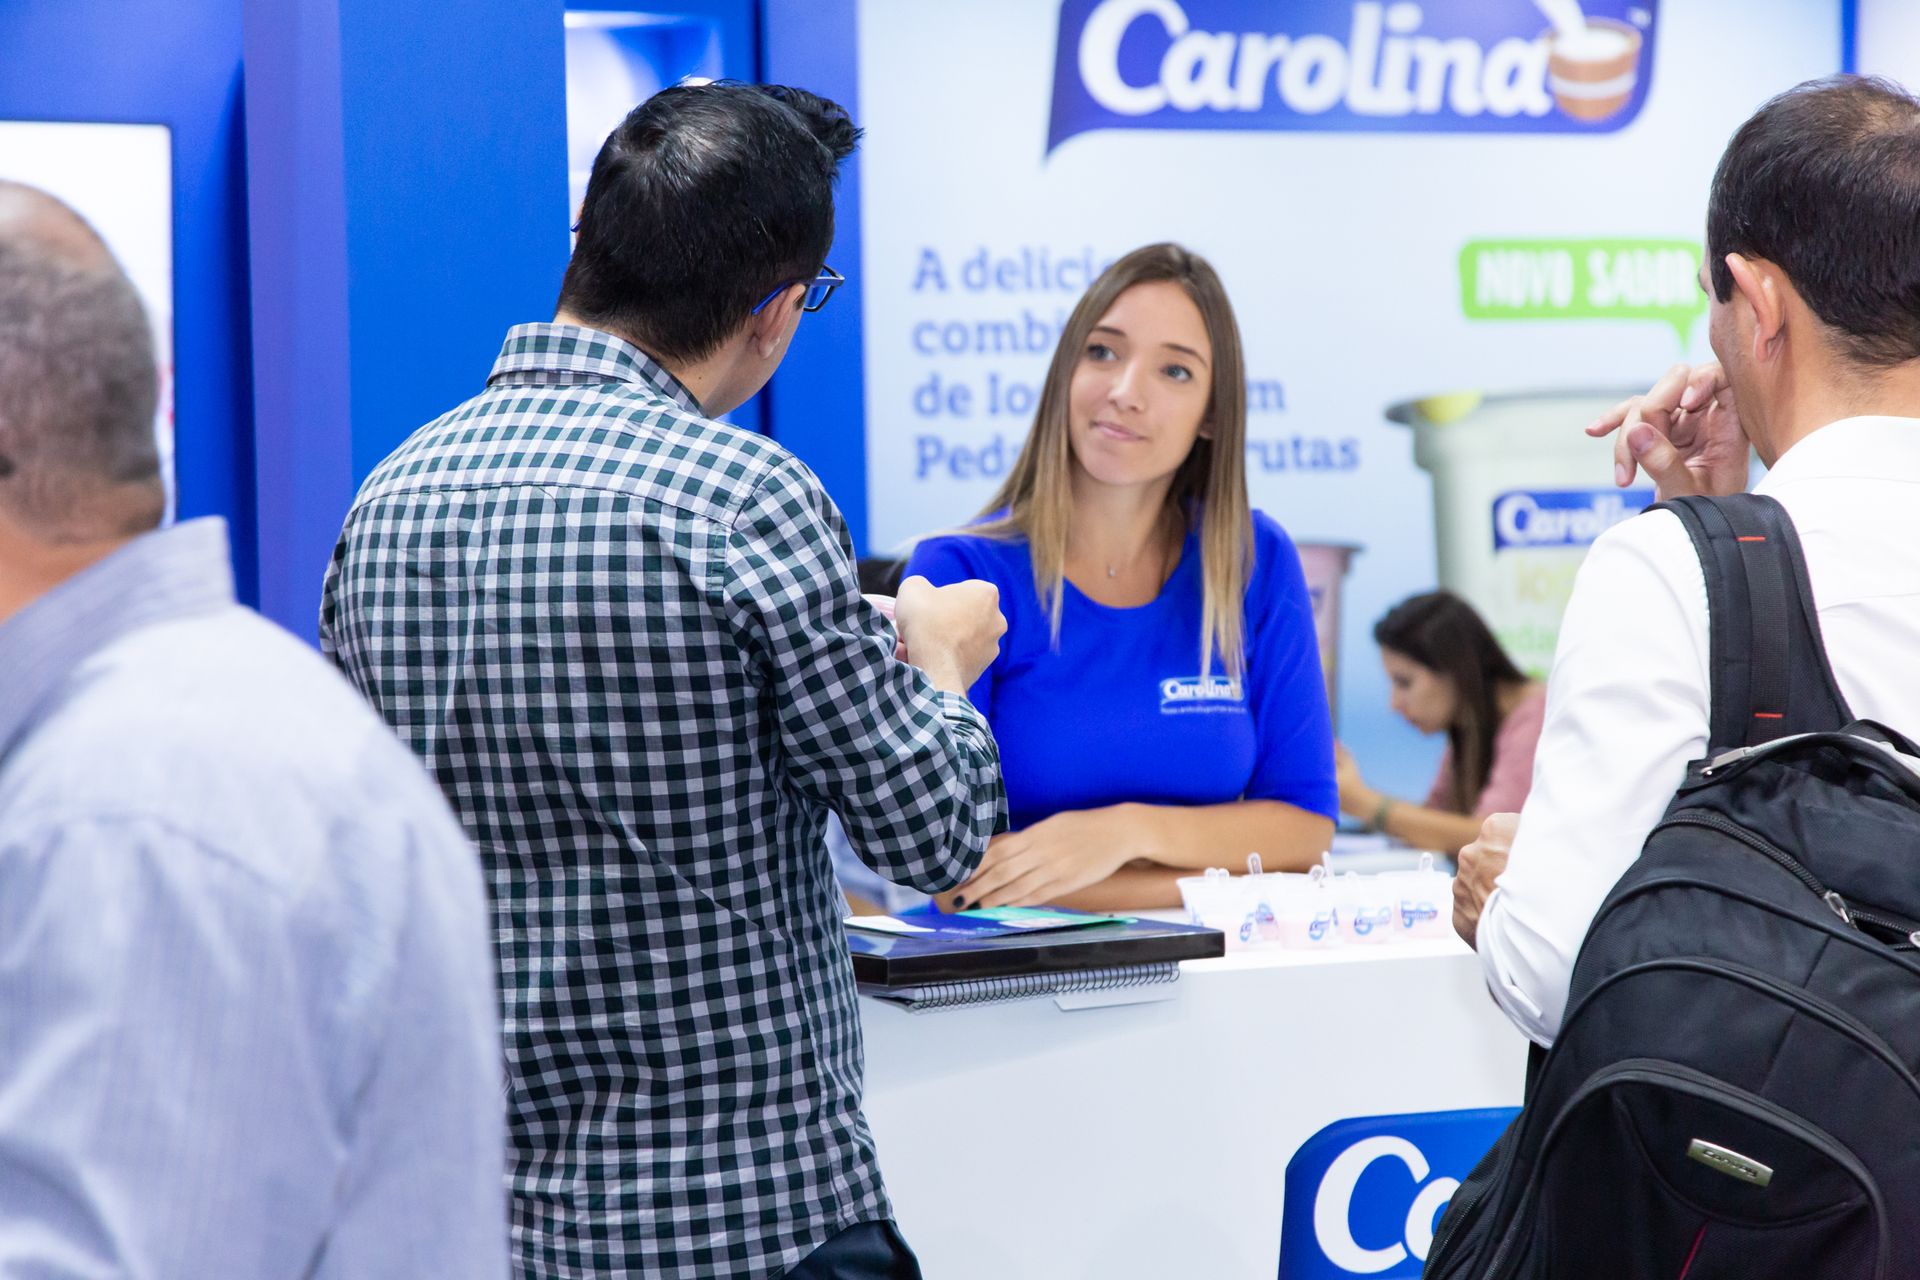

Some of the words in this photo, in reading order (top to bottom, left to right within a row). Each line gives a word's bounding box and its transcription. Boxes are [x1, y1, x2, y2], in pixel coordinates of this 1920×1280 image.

[1078, 0, 1552, 117] Carolina
[913, 246, 947, 293] A
[912, 309, 1070, 354] combi
[913, 371, 973, 418] de
